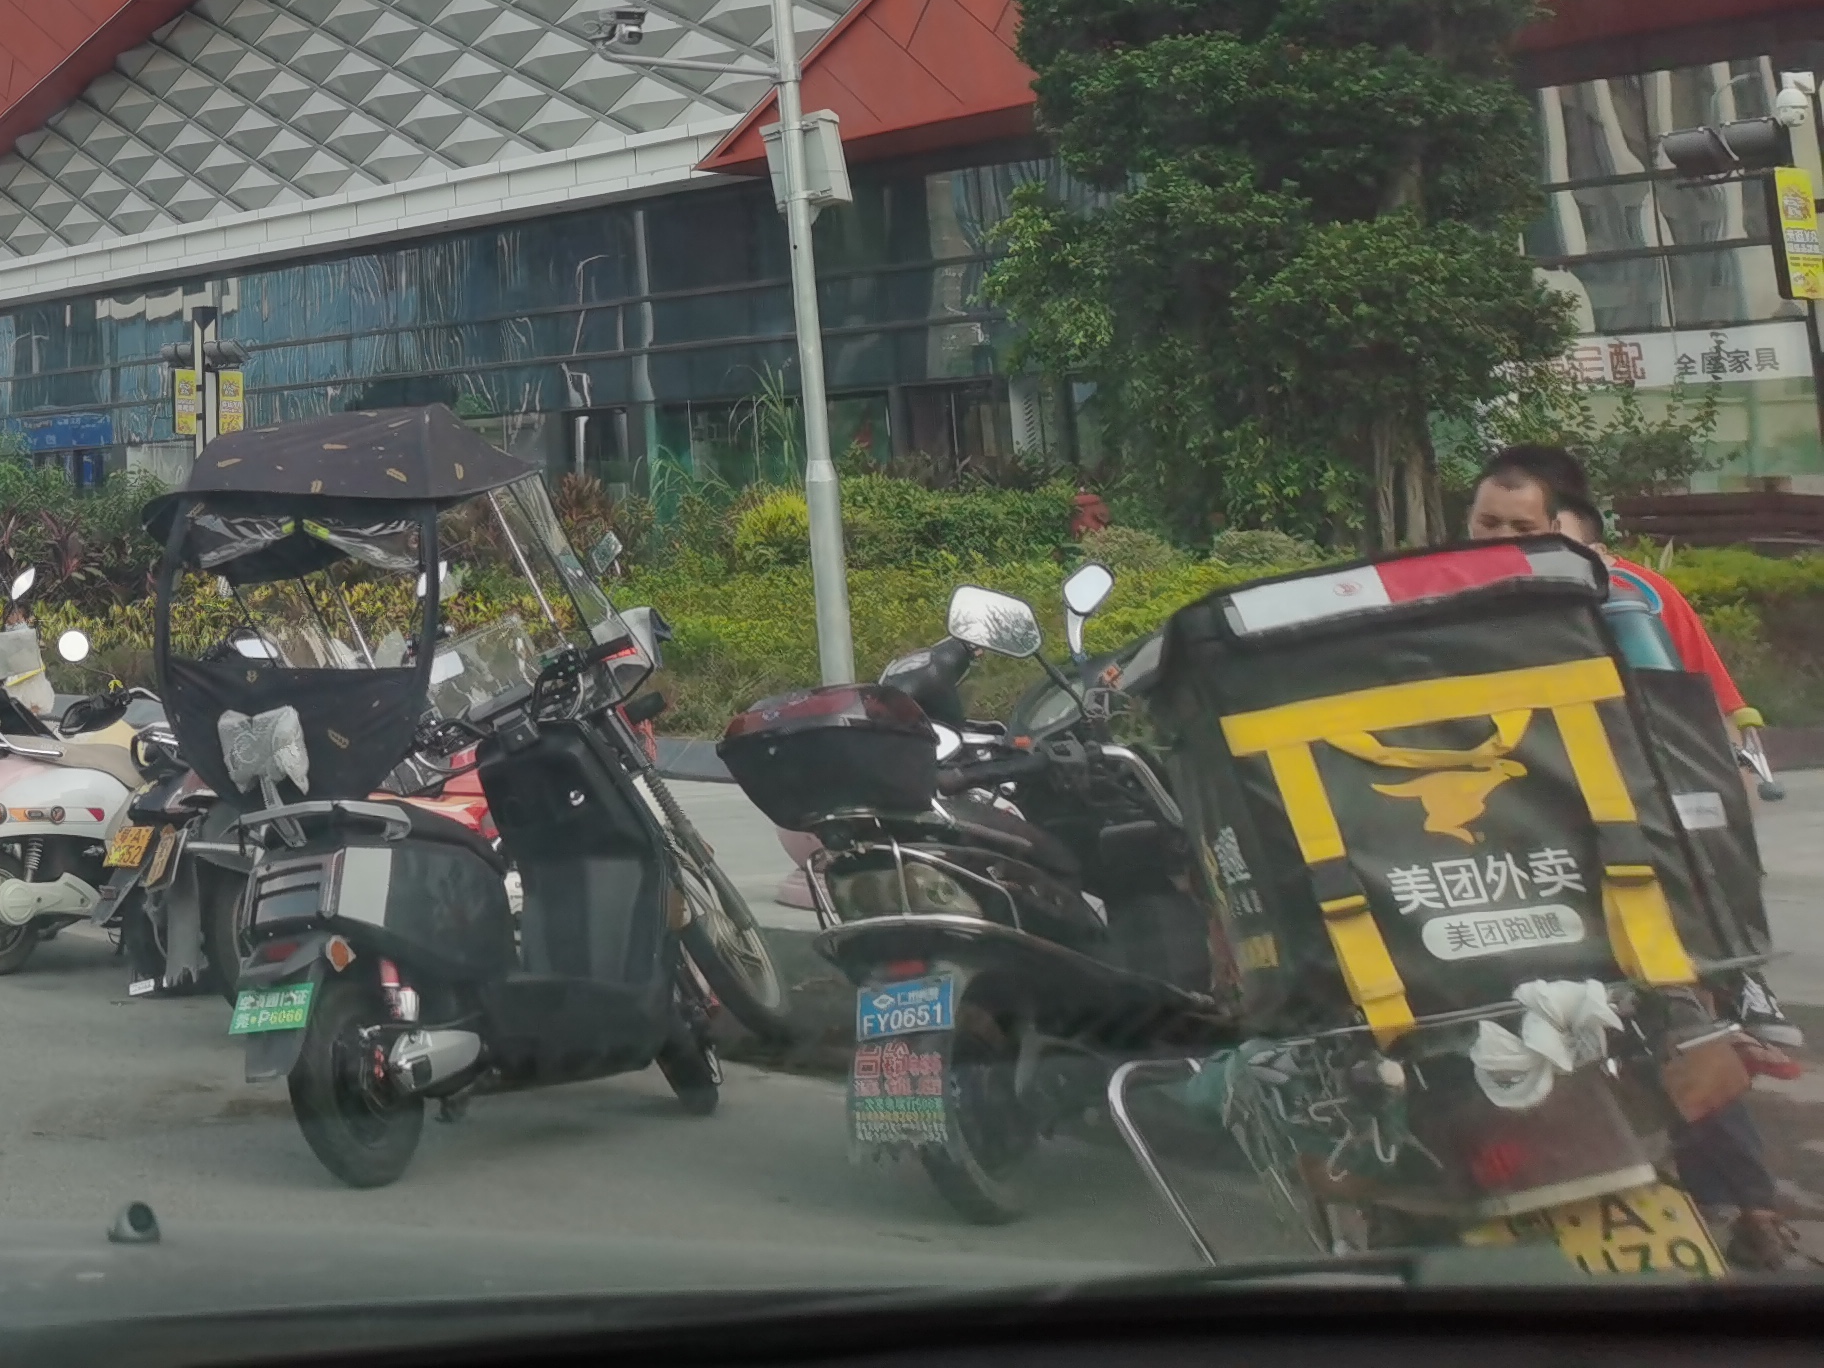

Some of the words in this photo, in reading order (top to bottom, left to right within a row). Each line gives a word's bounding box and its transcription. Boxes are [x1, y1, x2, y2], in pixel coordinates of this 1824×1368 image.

[1386, 847, 1587, 915] 美团外卖
[1444, 912, 1568, 953] 美团跑腿
[863, 1002, 943, 1036] FY0651
